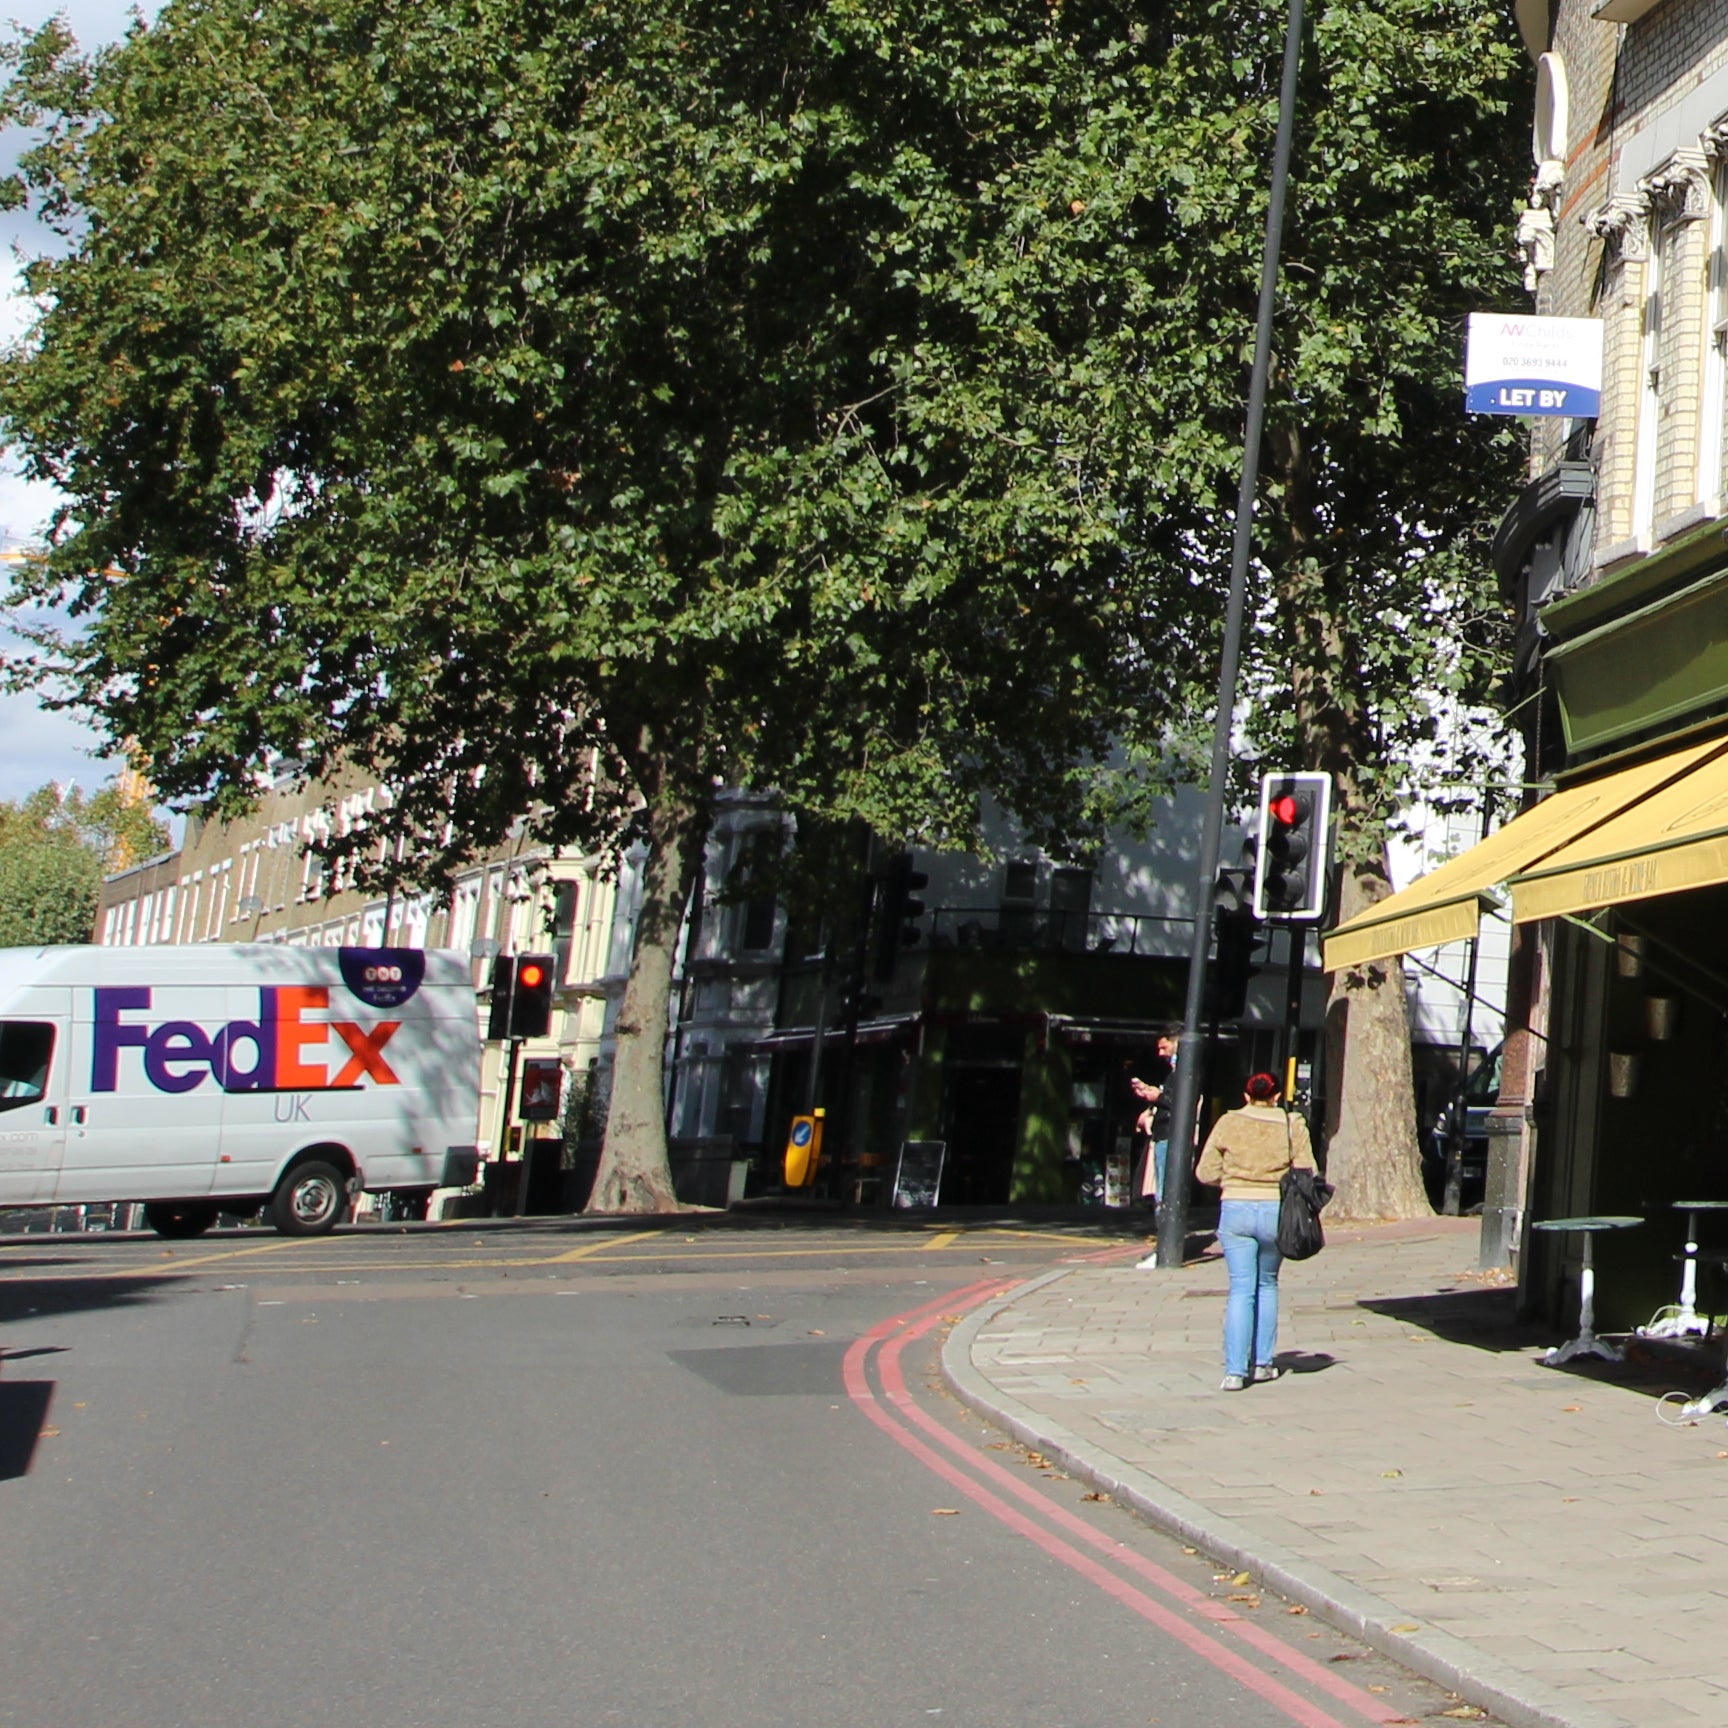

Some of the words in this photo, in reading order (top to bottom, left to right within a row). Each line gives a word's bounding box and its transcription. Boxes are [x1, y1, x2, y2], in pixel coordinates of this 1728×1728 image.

[1499, 388, 1536, 407] LET
[1540, 389, 1567, 408] BY
[91, 986, 402, 1093] FedEx
[274, 1094, 313, 1123] UK
